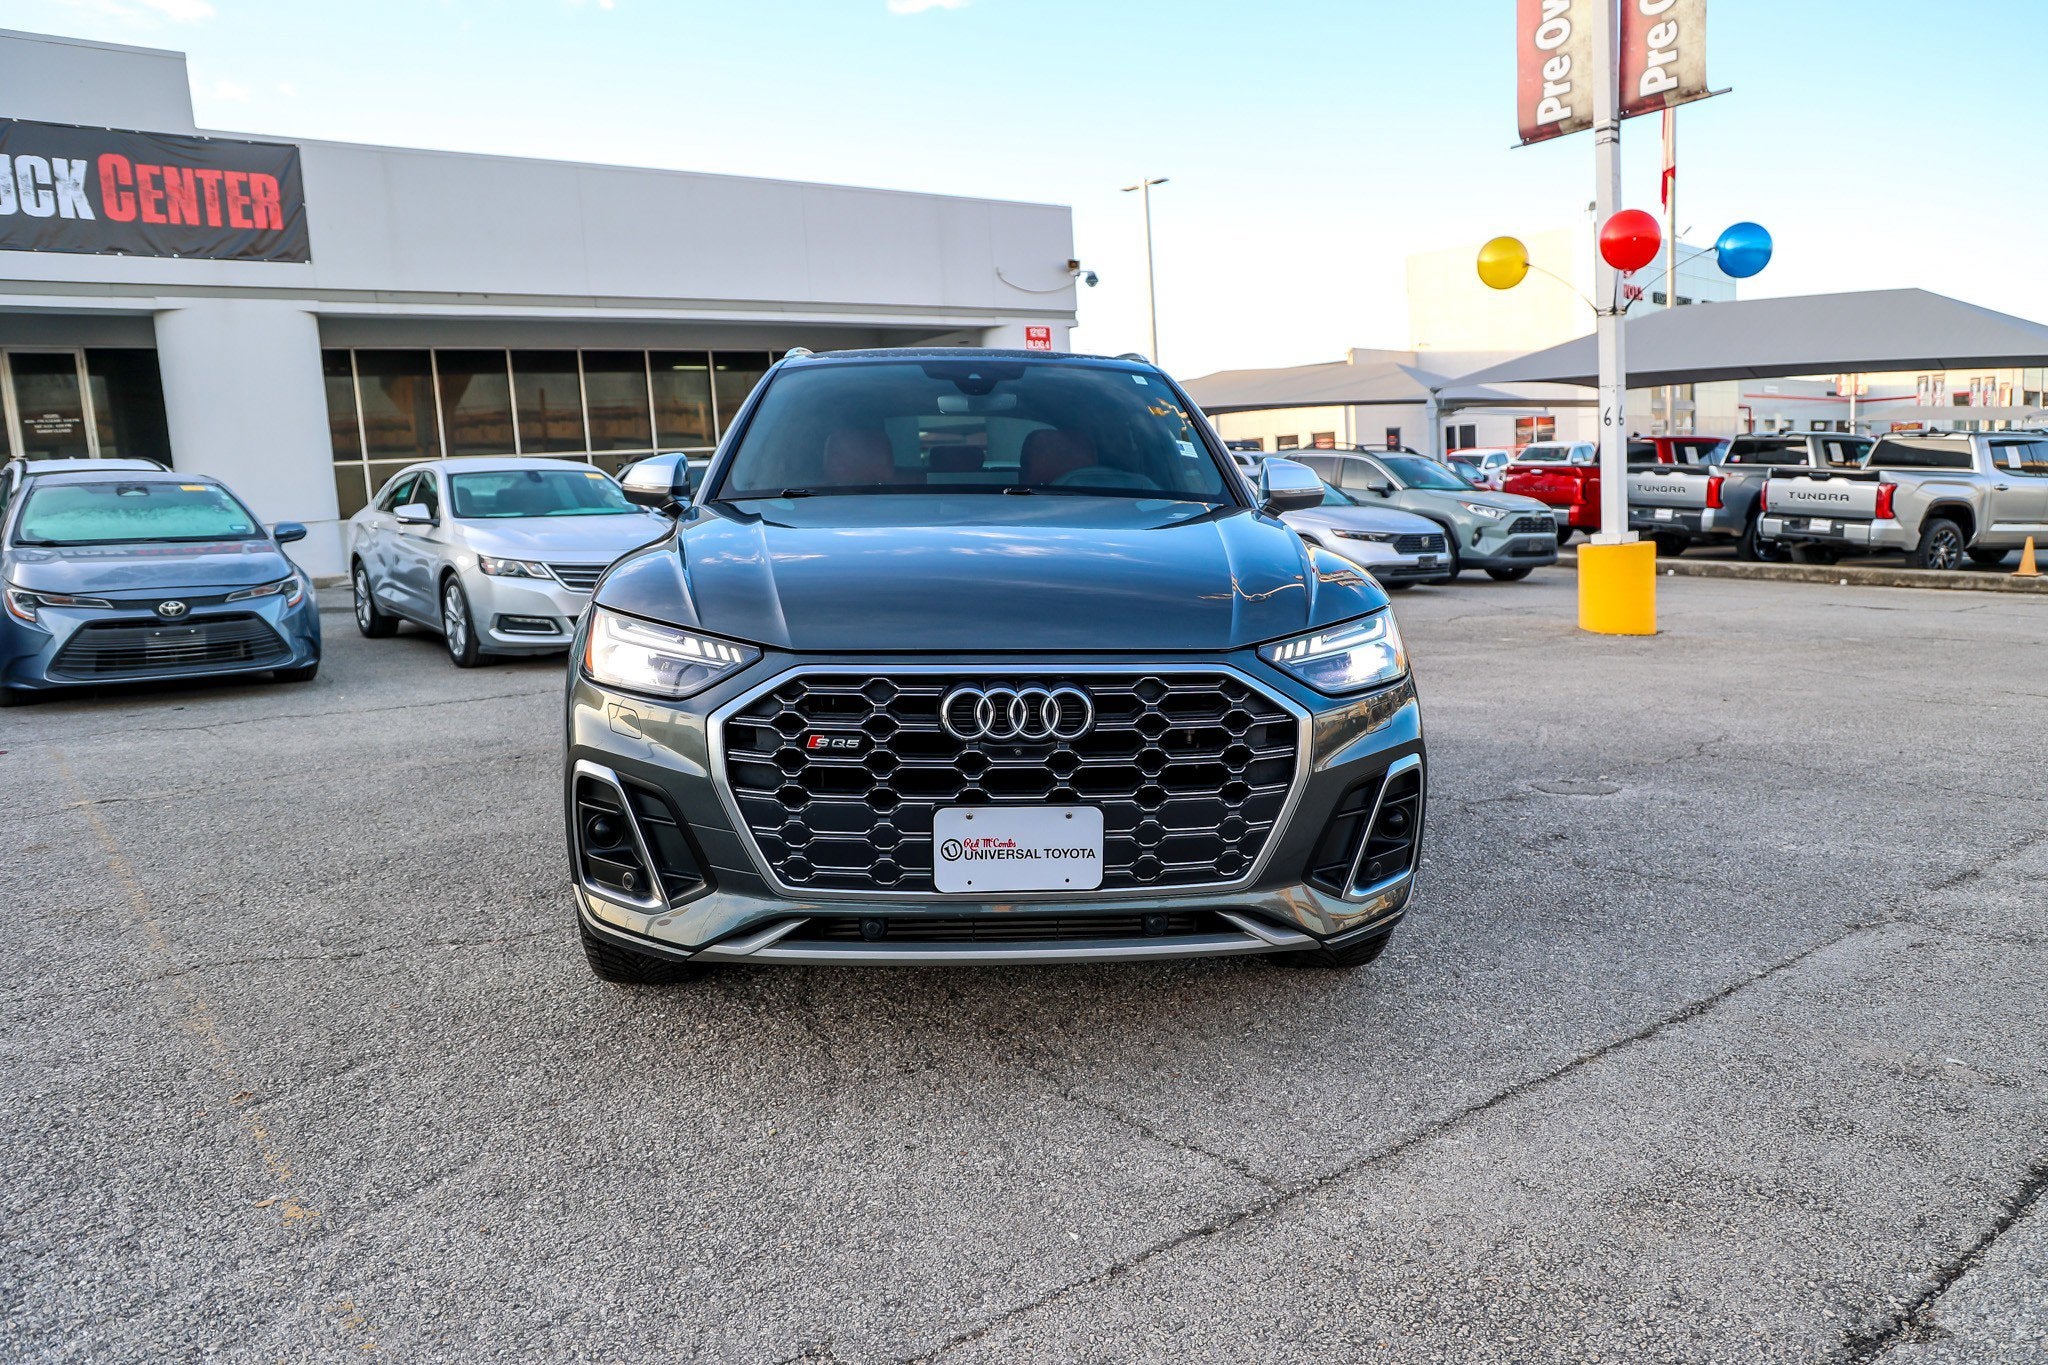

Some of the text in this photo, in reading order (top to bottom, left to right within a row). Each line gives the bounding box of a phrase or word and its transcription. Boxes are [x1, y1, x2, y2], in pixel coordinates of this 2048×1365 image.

[1639, 19, 1679, 97] Pre
[1536, 53, 1573, 126] Pre
[97, 153, 284, 230] CENTER
[1636, 484, 1687, 494] TUNDRA
[1788, 491, 1850, 502] TUNDRA
[807, 735, 860, 749] SQ5
[963, 838, 980, 851] Red
[964, 848, 1096, 860] UNIVERSAL TOYOTA
